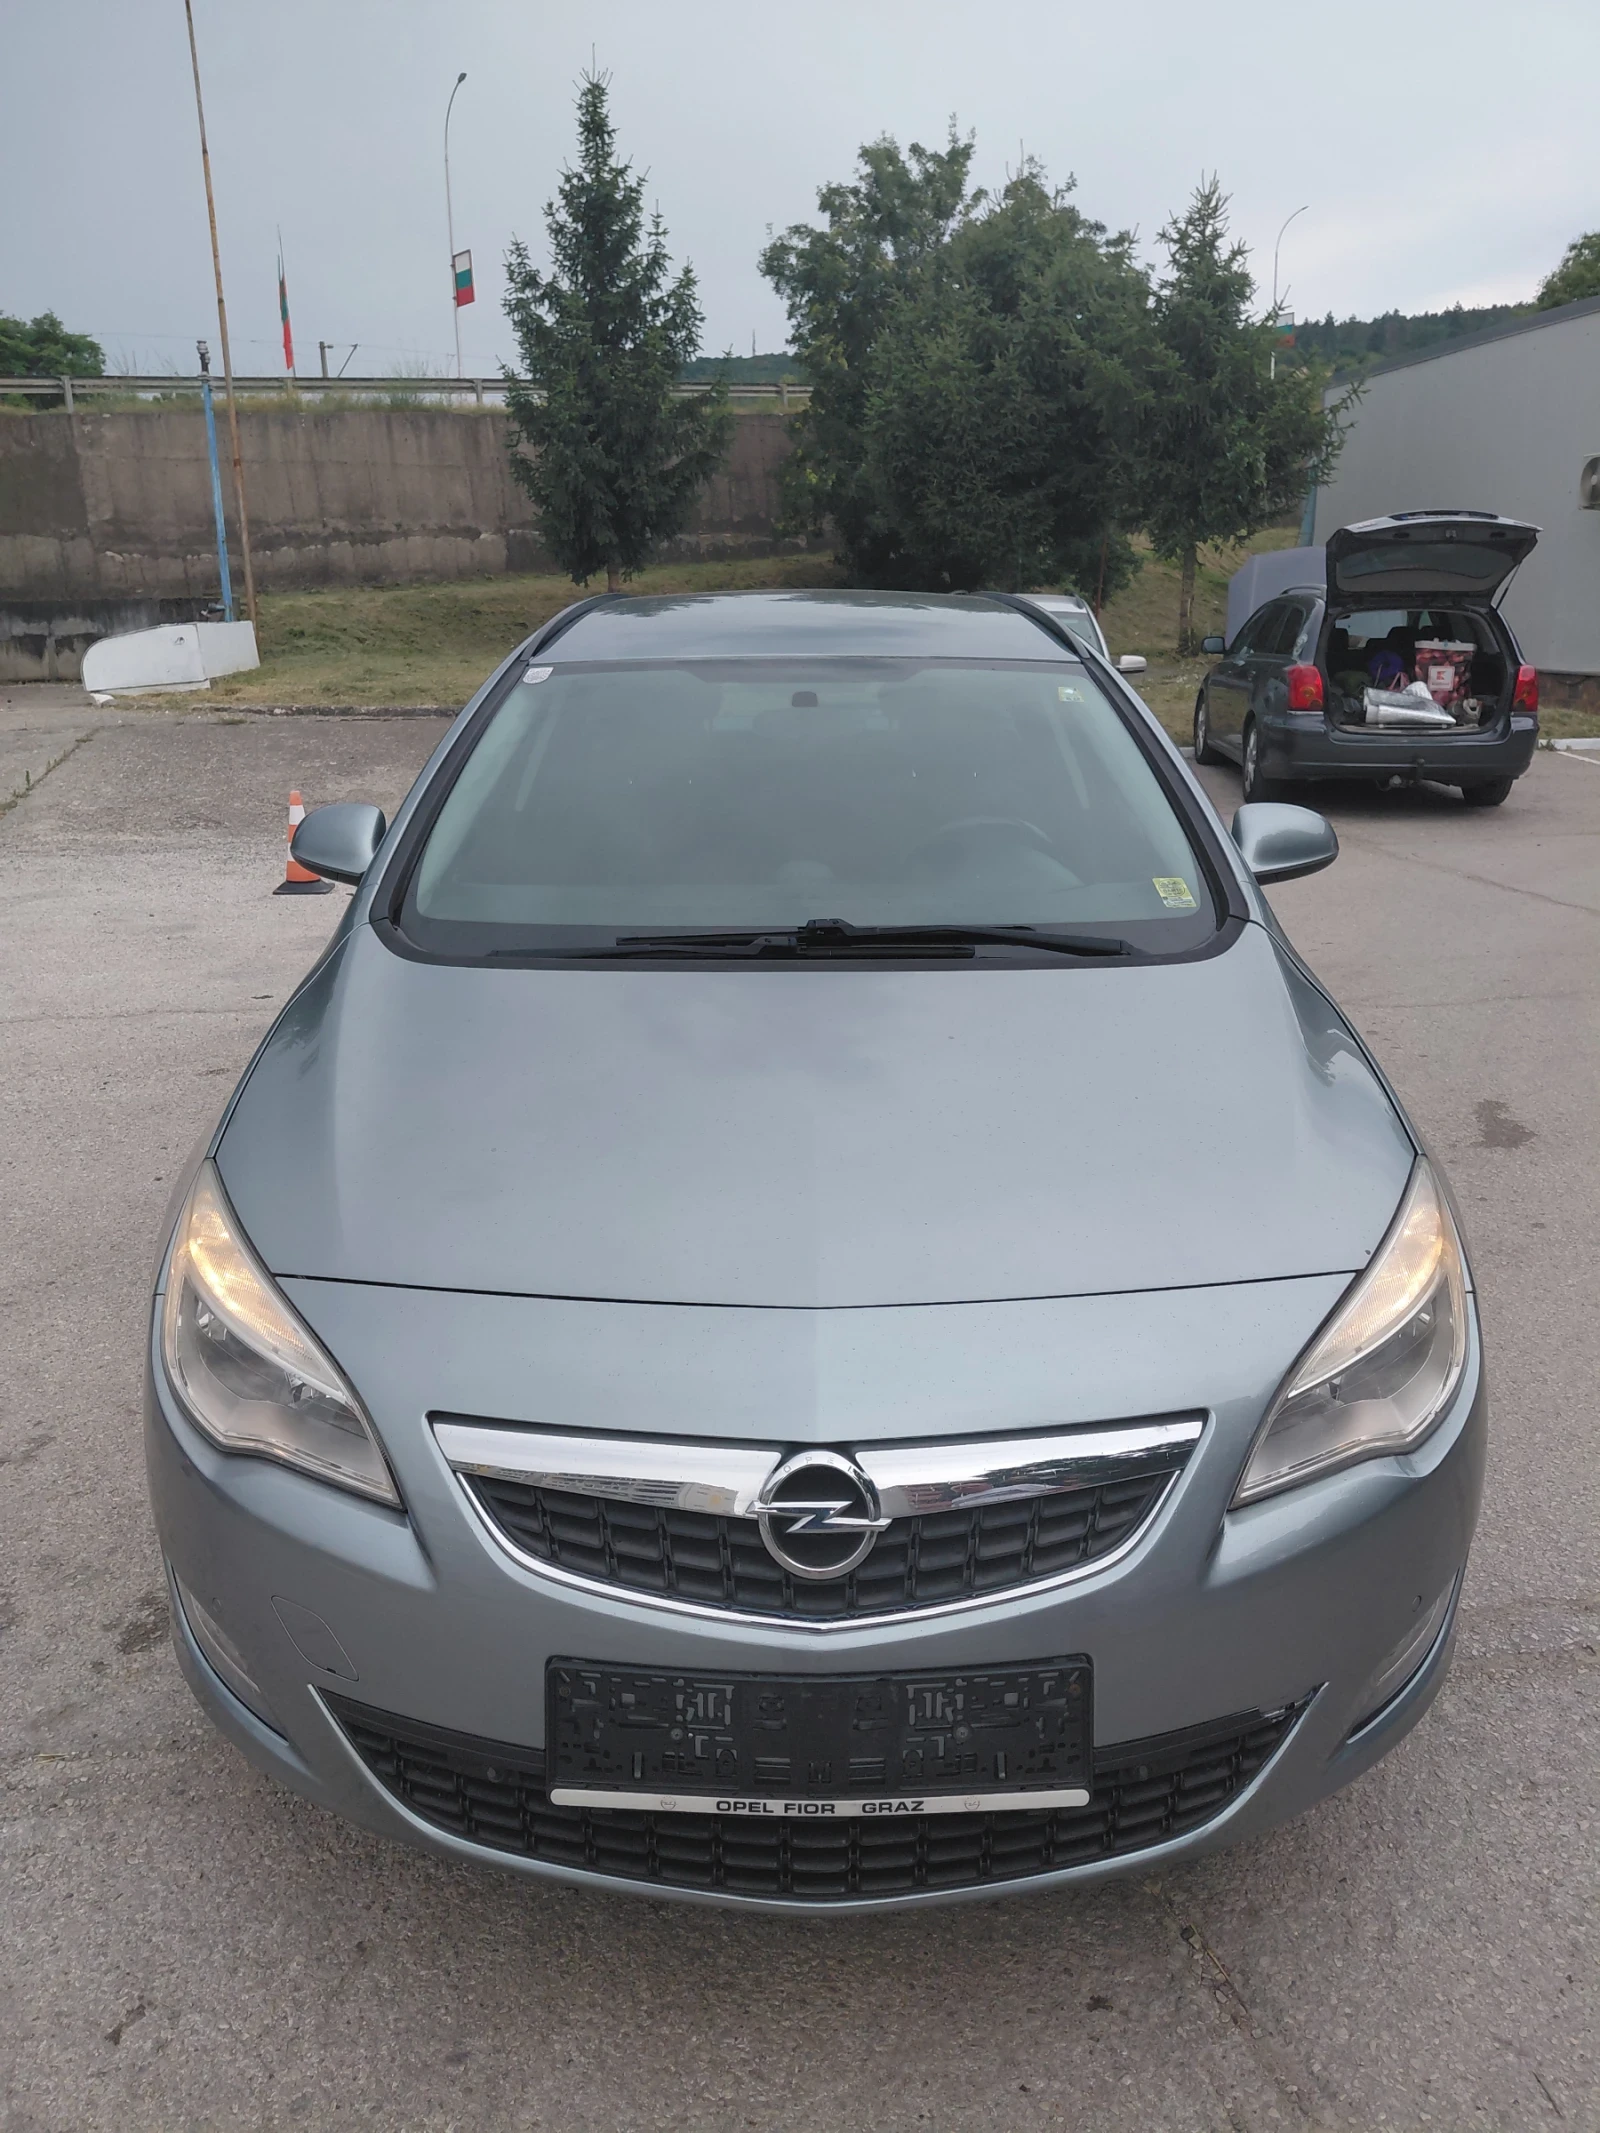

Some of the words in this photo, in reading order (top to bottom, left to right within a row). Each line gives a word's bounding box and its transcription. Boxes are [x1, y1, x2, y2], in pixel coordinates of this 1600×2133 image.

[716, 1800, 774, 1813] OPEL
[784, 1803, 836, 1814] FIOR
[861, 1801, 924, 1814] GRAZ
